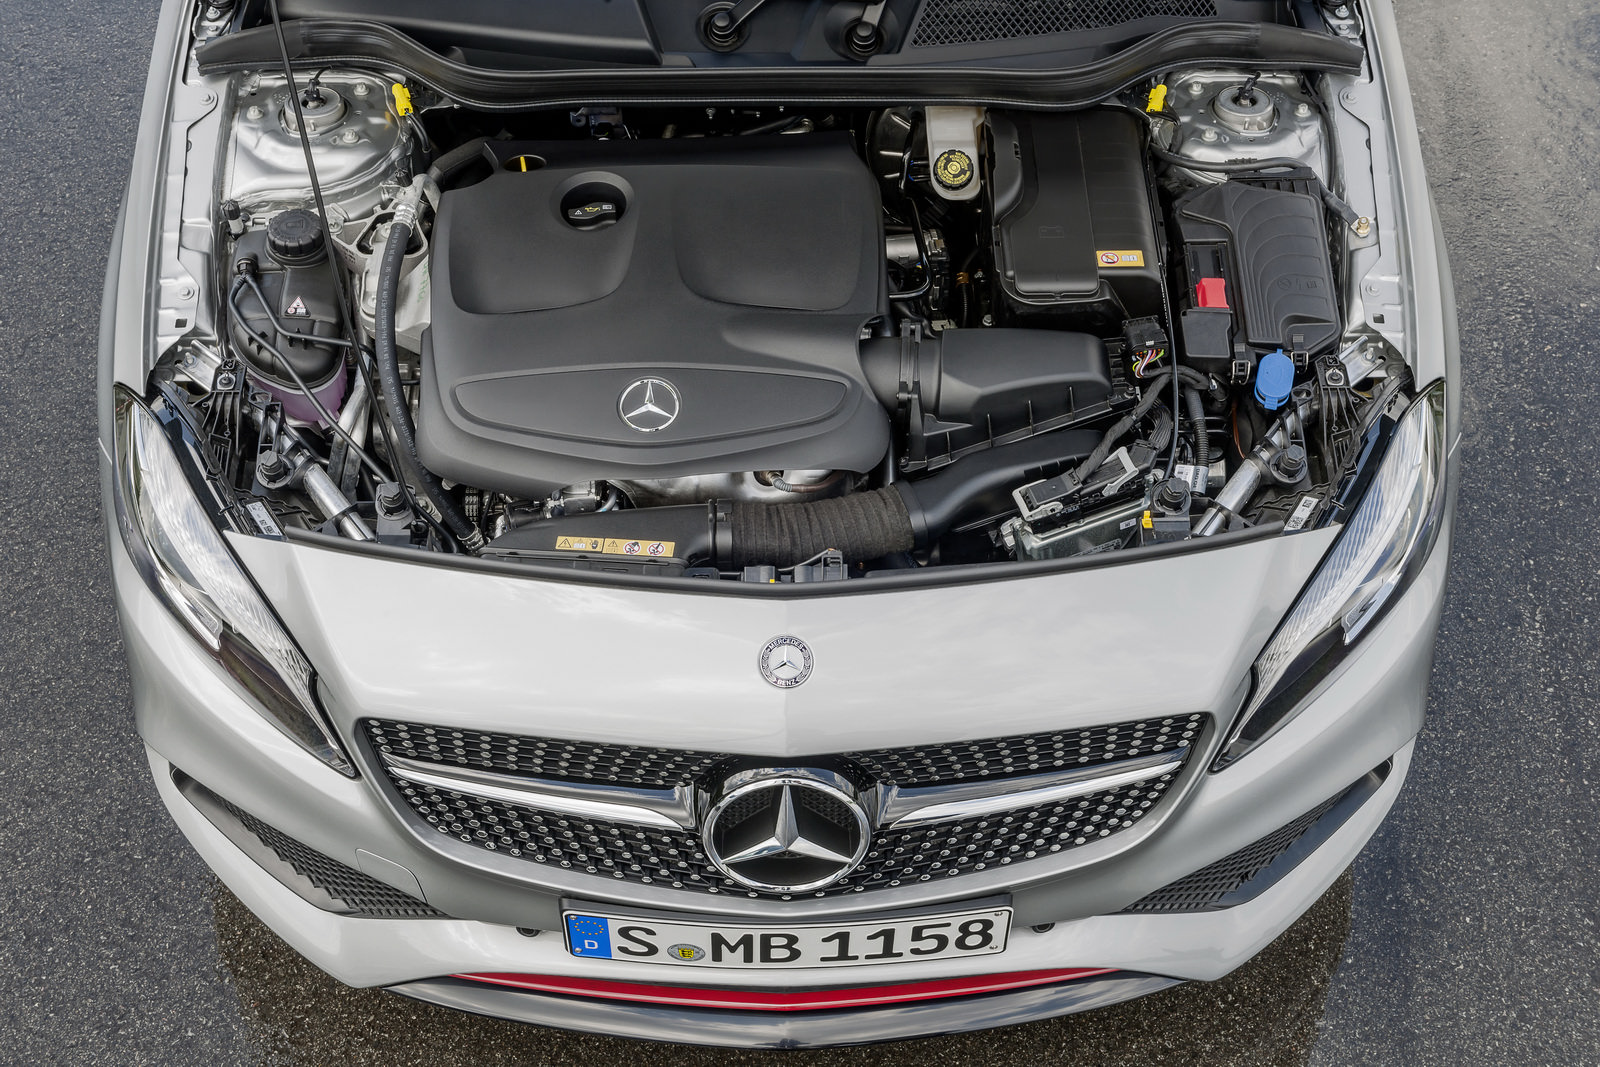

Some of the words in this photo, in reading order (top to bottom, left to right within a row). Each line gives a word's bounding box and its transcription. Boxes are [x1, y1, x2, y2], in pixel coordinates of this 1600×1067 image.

[584, 939, 599, 950] D
[617, 926, 659, 957] S
[710, 932, 802, 964] MB
[819, 918, 994, 962] 1158
